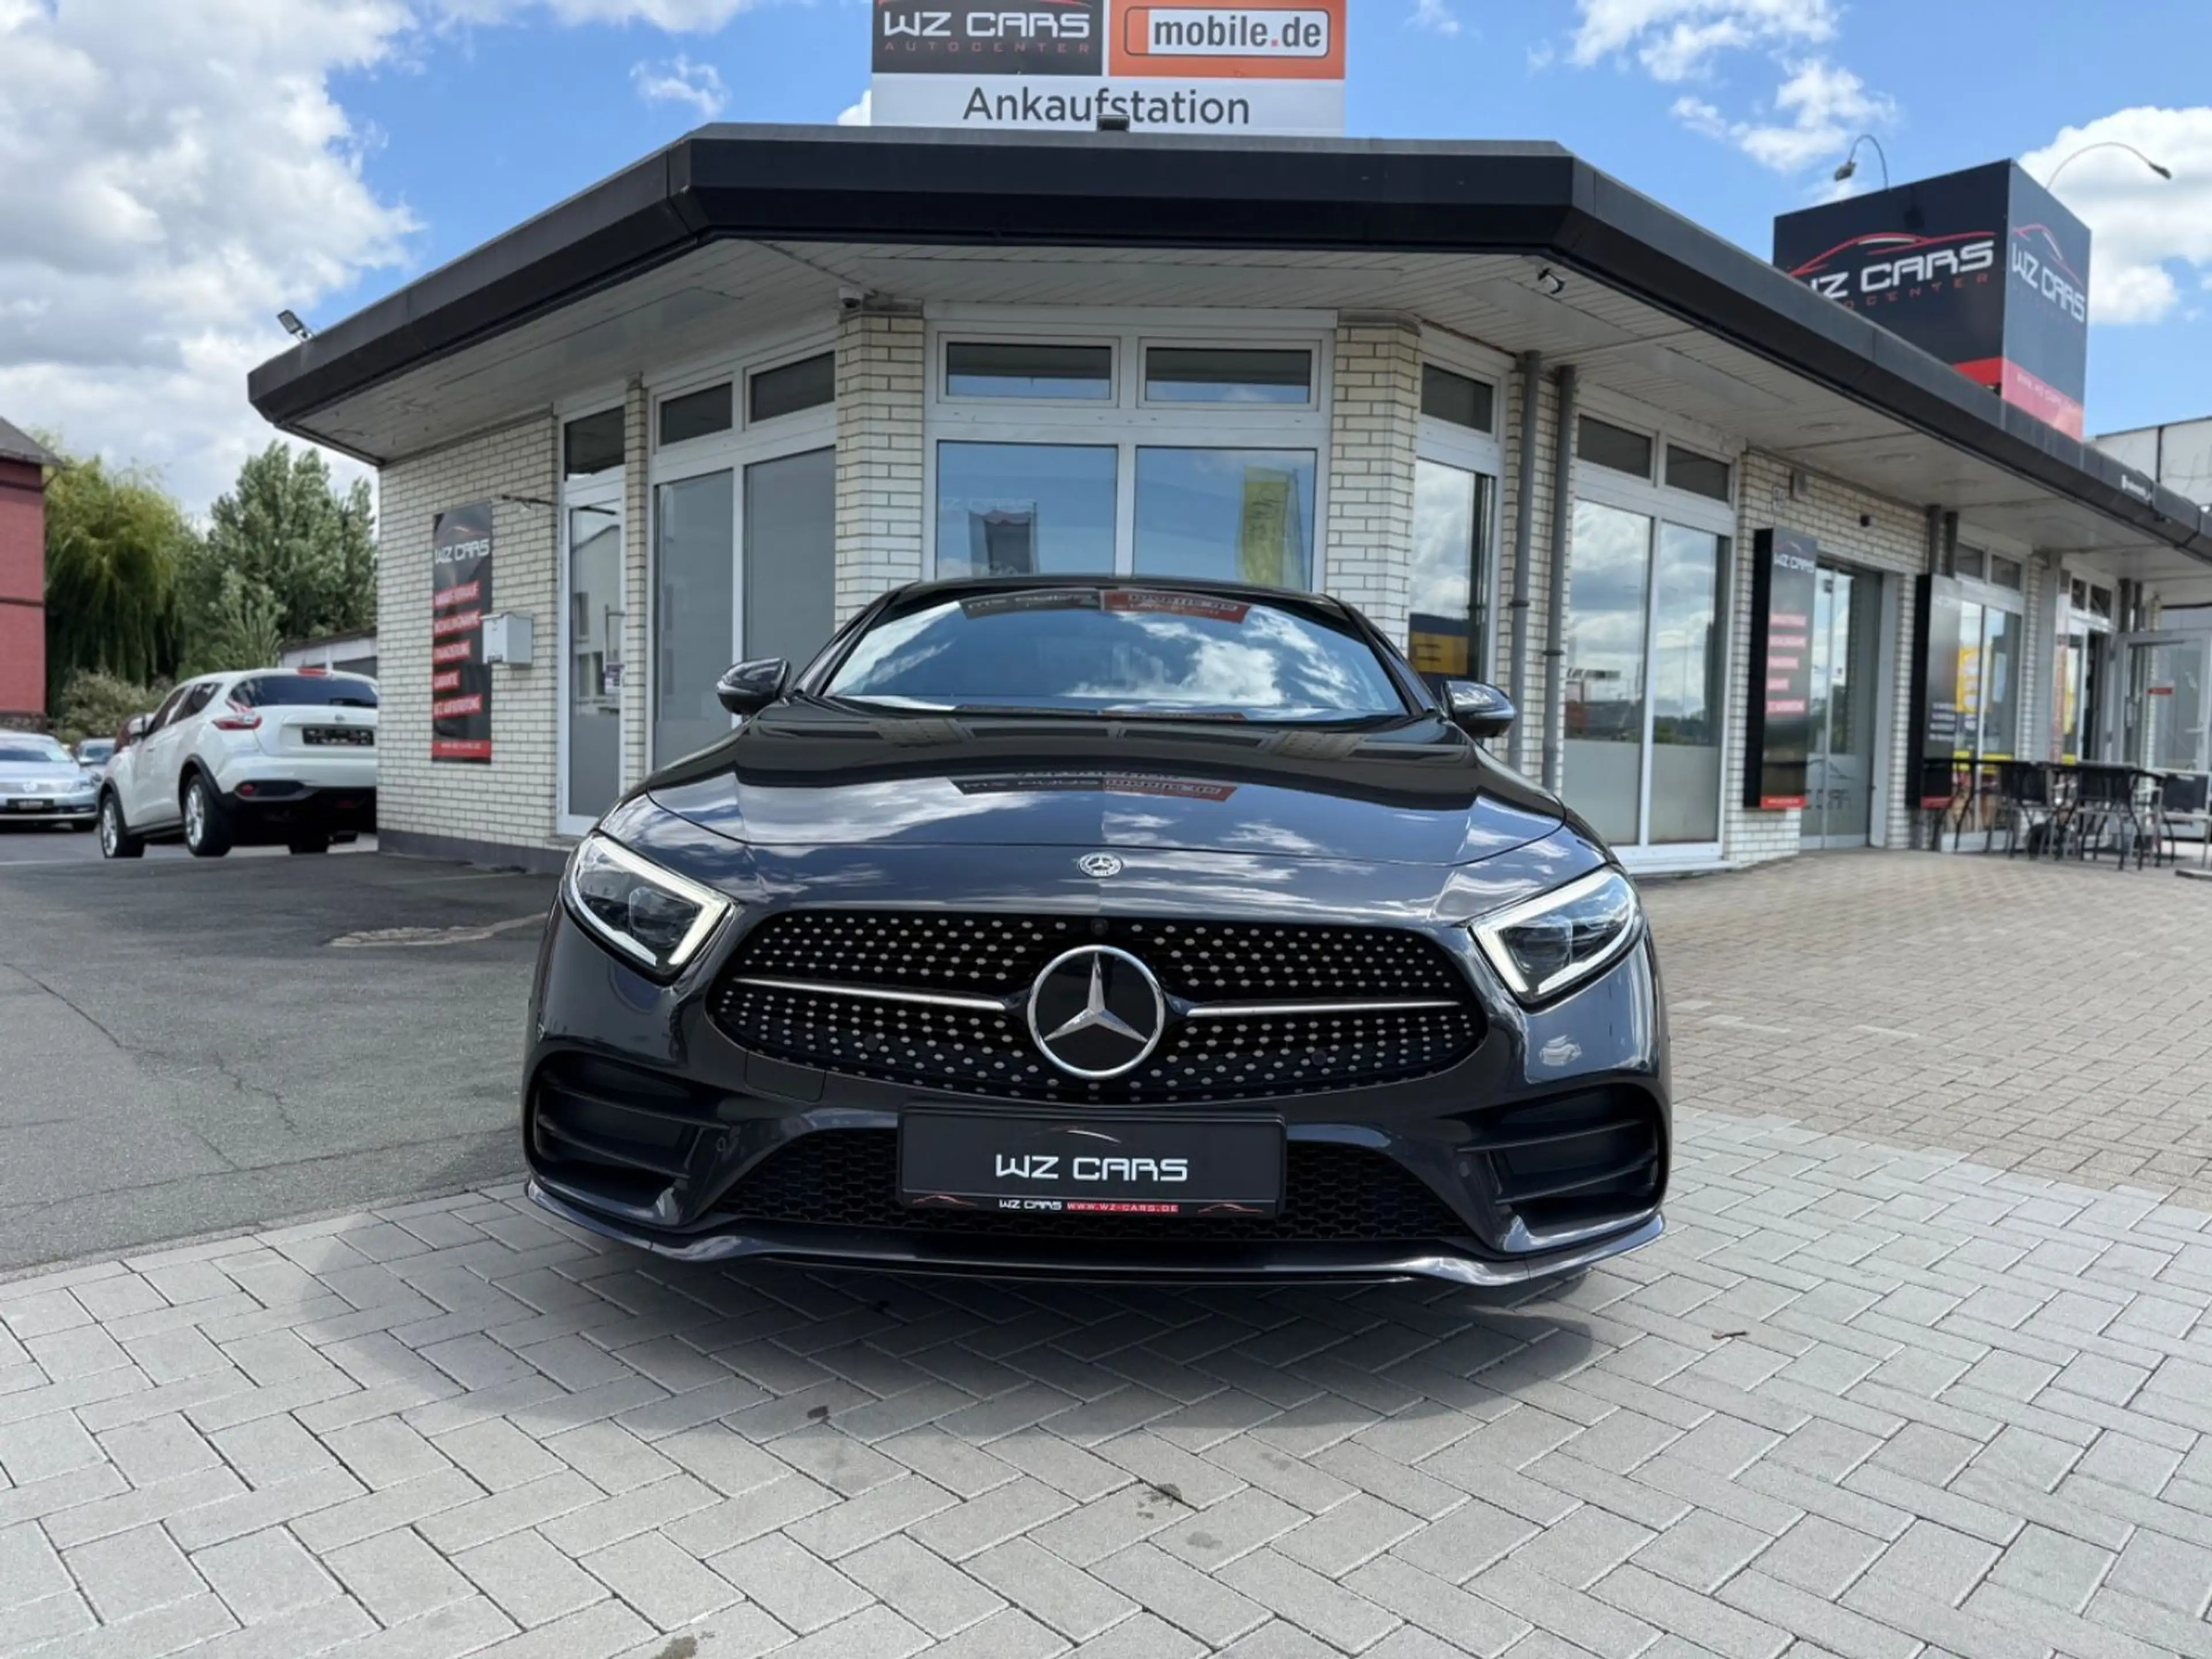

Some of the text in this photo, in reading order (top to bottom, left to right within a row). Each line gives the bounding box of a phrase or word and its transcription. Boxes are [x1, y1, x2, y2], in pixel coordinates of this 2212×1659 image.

[884, 11, 1090, 38] WZ CARS
[1154, 15, 1322, 48] mobile.de
[884, 41, 1090, 54] AUTOCENTER
[963, 86, 1250, 126] Ankaufstation
[1811, 240, 1995, 299] Z CARS
[2012, 242, 2085, 324] WZ CARS
[996, 1154, 1188, 1181] WZ CARS
[999, 1199, 1179, 1213] WZ CARS WWW.WZ-CARS.DE
